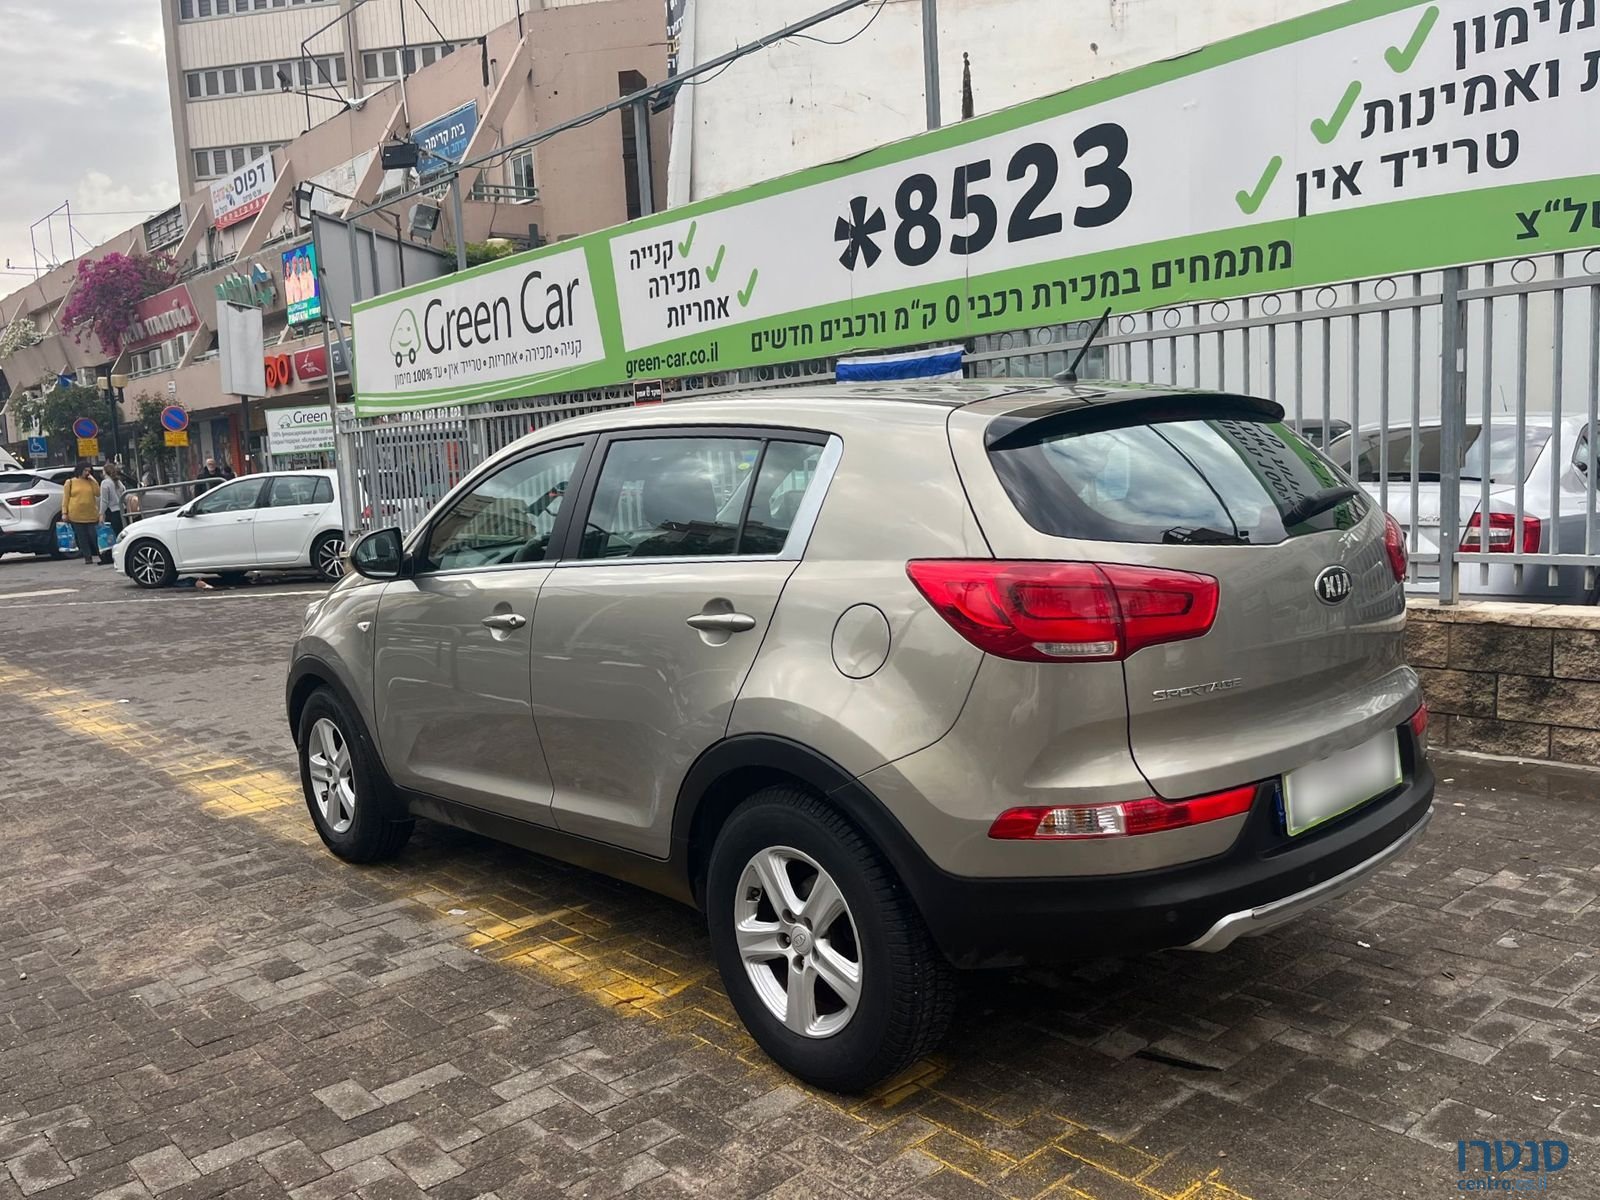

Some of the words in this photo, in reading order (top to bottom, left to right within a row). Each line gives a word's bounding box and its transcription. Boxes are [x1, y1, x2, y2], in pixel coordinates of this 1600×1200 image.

[1361, 59, 1559, 139] ואמינות
[450, 122, 466, 139] בית
[1380, 129, 1519, 187] טרייד
[233, 163, 265, 195] דפוס
[1296, 160, 1363, 217] אין
[630, 240, 673, 270] קנייה
[1152, 239, 1292, 289] מתמחים
[648, 267, 701, 299] מכירה
[1031, 267, 1140, 309] במכירת
[424, 298, 512, 354] Green
[520, 270, 580, 334] Car
[667, 296, 730, 328] אחריות
[945, 294, 960, 323] 0
[968, 288, 1023, 319] רכבי
[751, 323, 813, 352] חדשים
[820, 310, 886, 342] ורכבים
[488, 351, 518, 369] אחריות
[525, 345, 553, 362] מכירה
[560, 339, 582, 358] קניה
[626, 341, 719, 378] green-car.co.il
[413, 367, 432, 383] 100%
[433, 366, 442, 379] עד
[447, 361, 459, 380] אין
[461, 358, 482, 373] טרייד
[394, 371, 412, 390] מימון
[293, 410, 328, 424] Green
[1322, 572, 1352, 599] KIA
[1152, 677, 1243, 702] SPORTAGE
